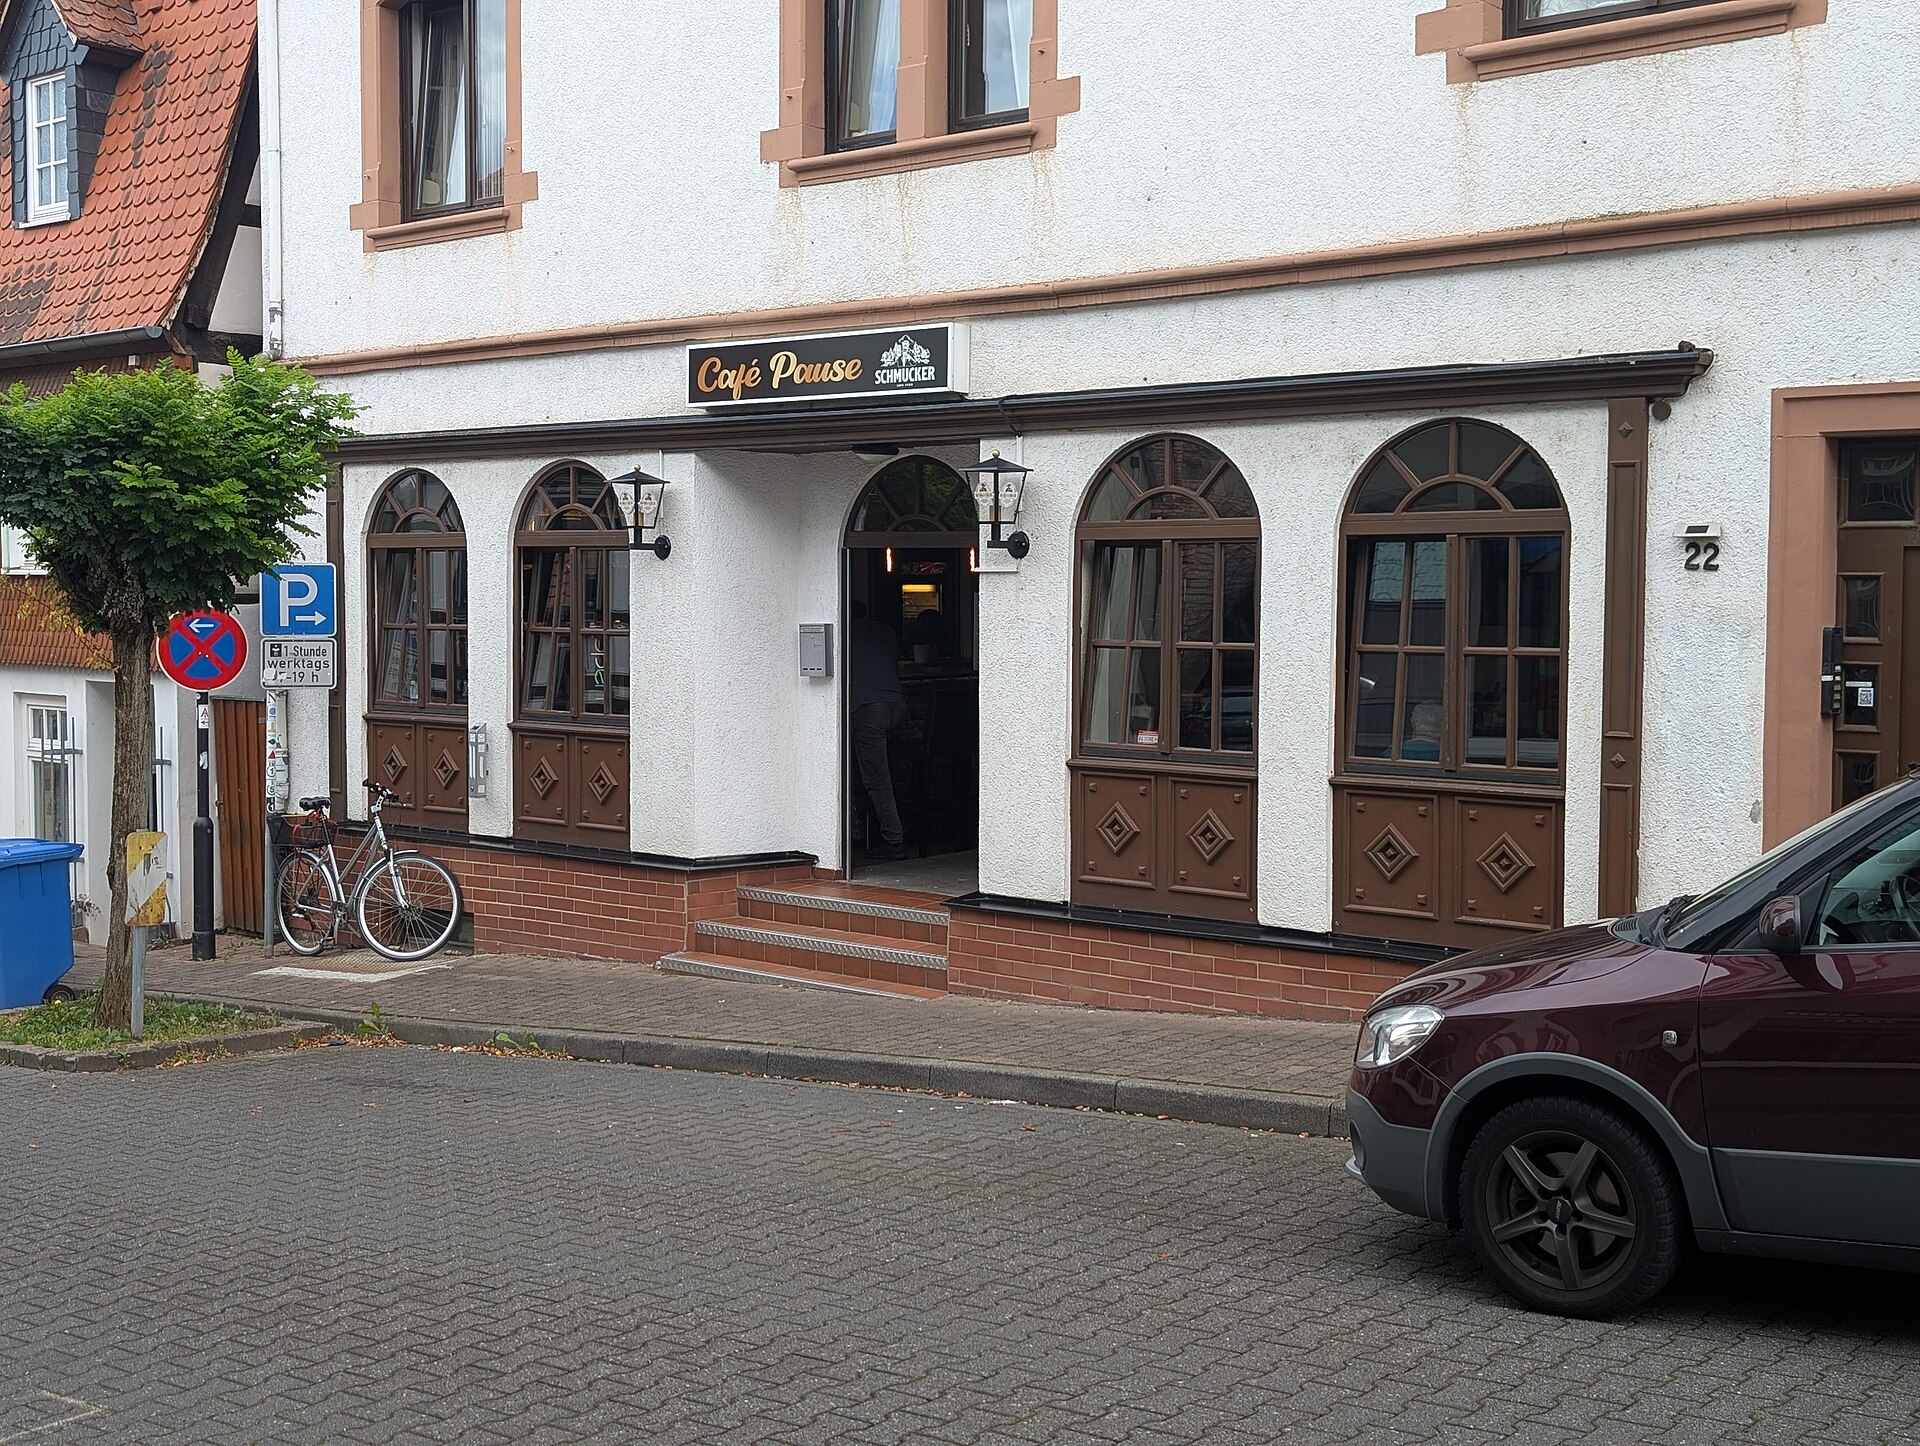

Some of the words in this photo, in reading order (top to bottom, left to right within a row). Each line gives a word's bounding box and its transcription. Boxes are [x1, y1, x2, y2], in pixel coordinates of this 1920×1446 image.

[697, 356, 762, 400] Café
[769, 350, 863, 389] Pause
[874, 366, 936, 384] SCHMUCKER
[1684, 541, 1719, 571] 22
[279, 573, 318, 627] P
[284, 645, 288, 657] 1
[293, 645, 327, 657] Stunde
[267, 658, 330, 671] werktags
[311, 671, 319, 683] h
